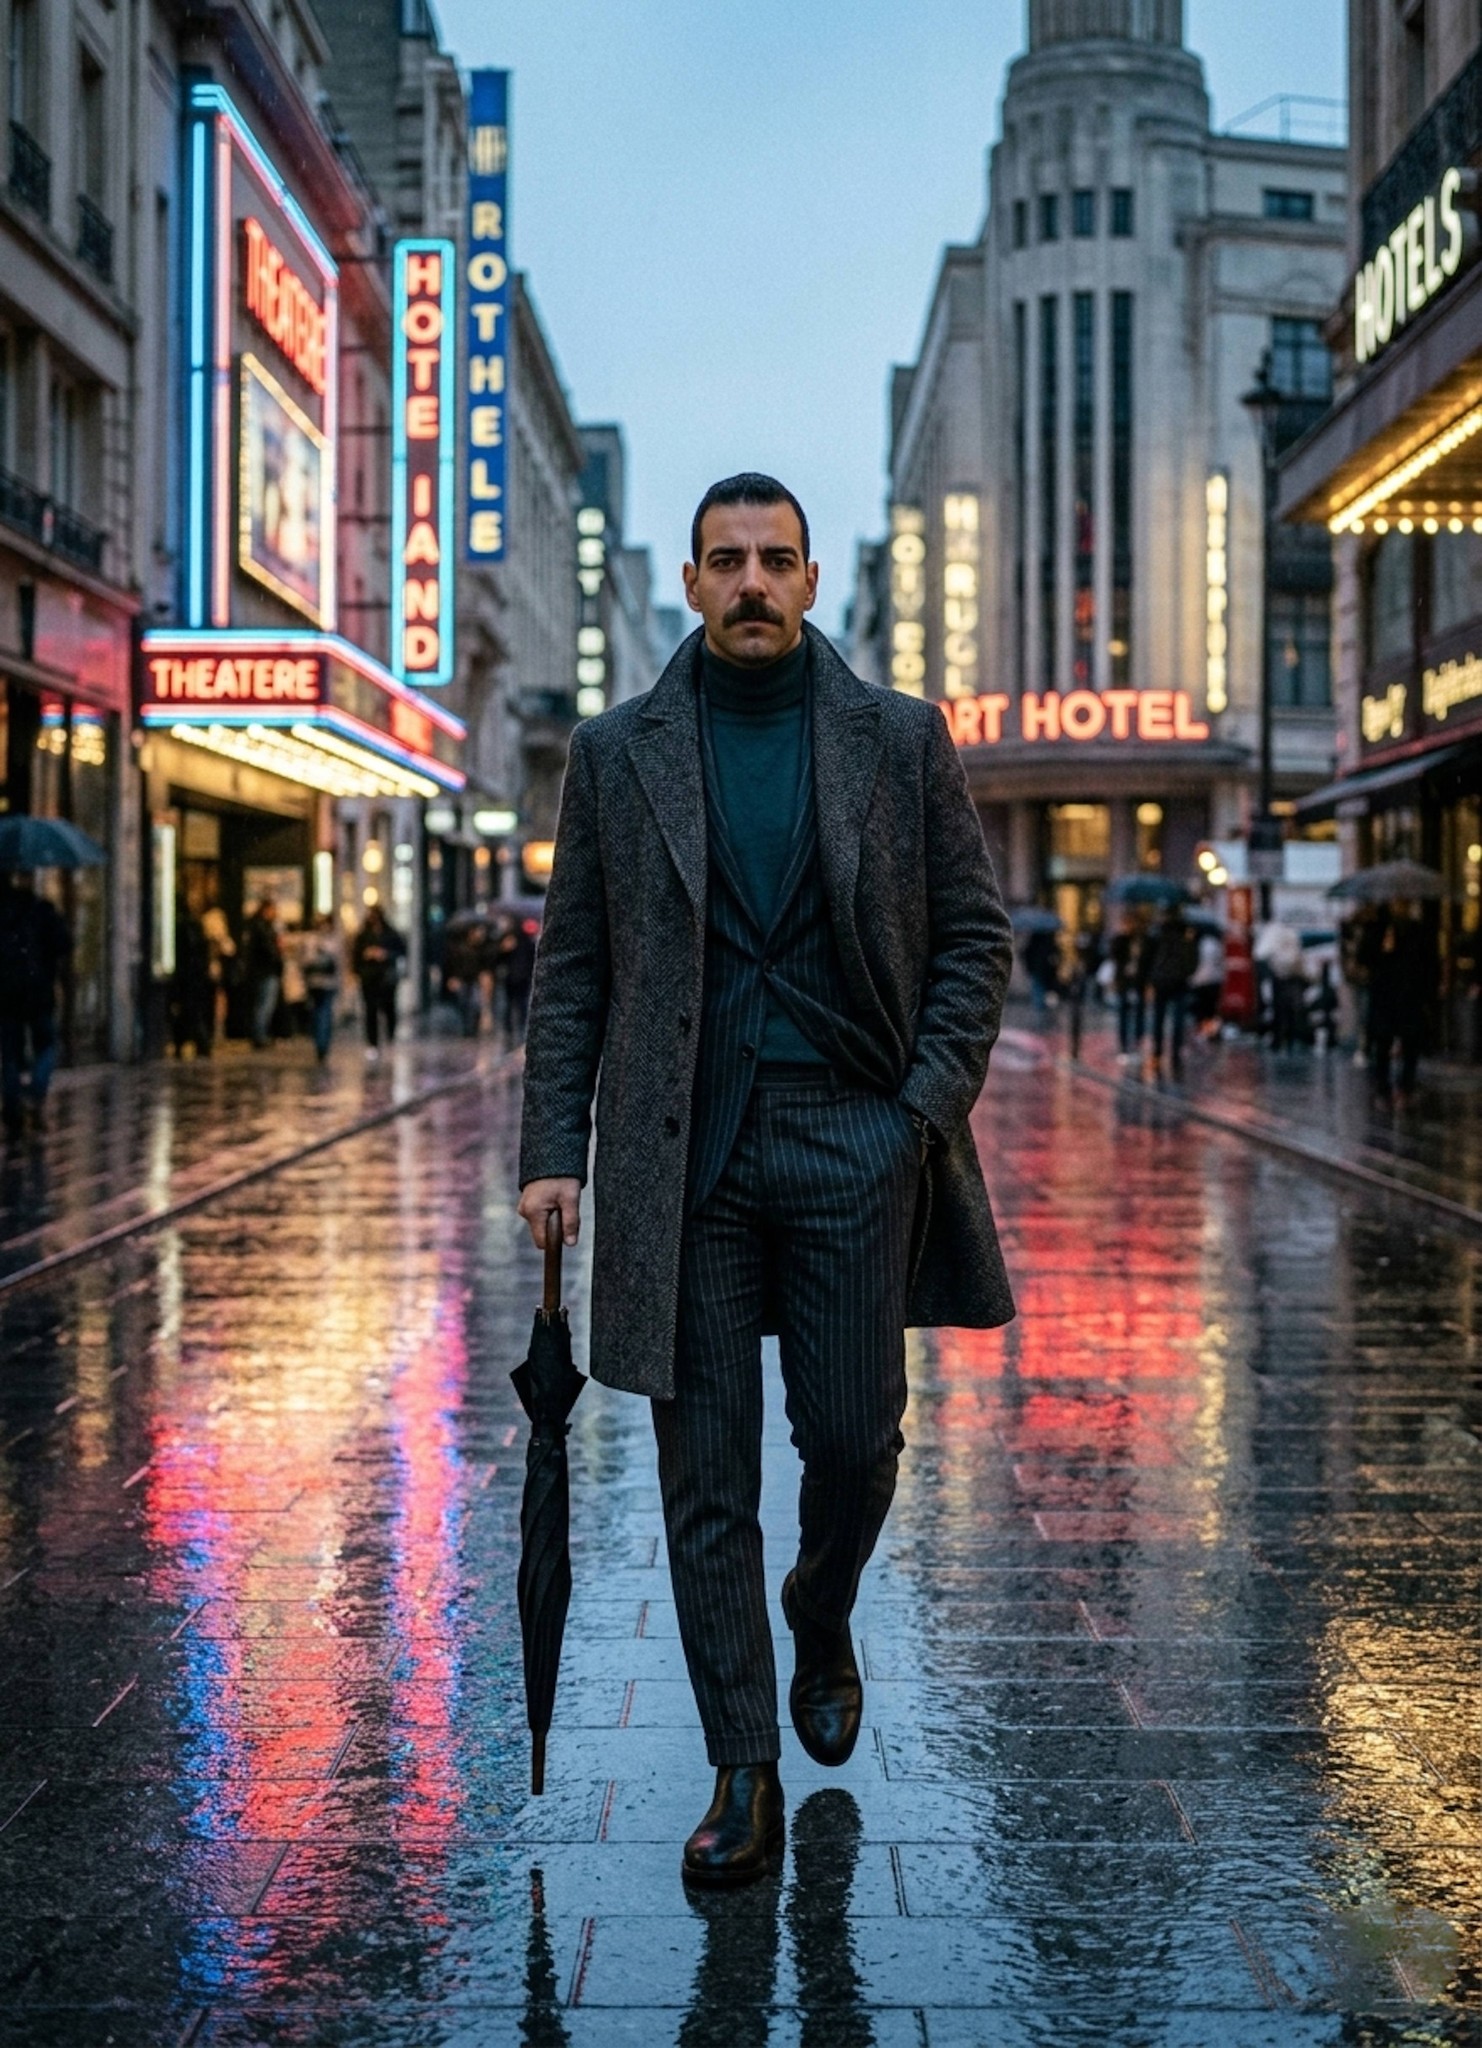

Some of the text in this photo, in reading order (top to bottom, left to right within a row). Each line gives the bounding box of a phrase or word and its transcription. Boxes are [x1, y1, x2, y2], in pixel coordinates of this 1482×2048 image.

[1355, 167, 1462, 364] HOTELS
[150, 658, 320, 700] THEATERE
[1021, 688, 1210, 742] HOTEL
